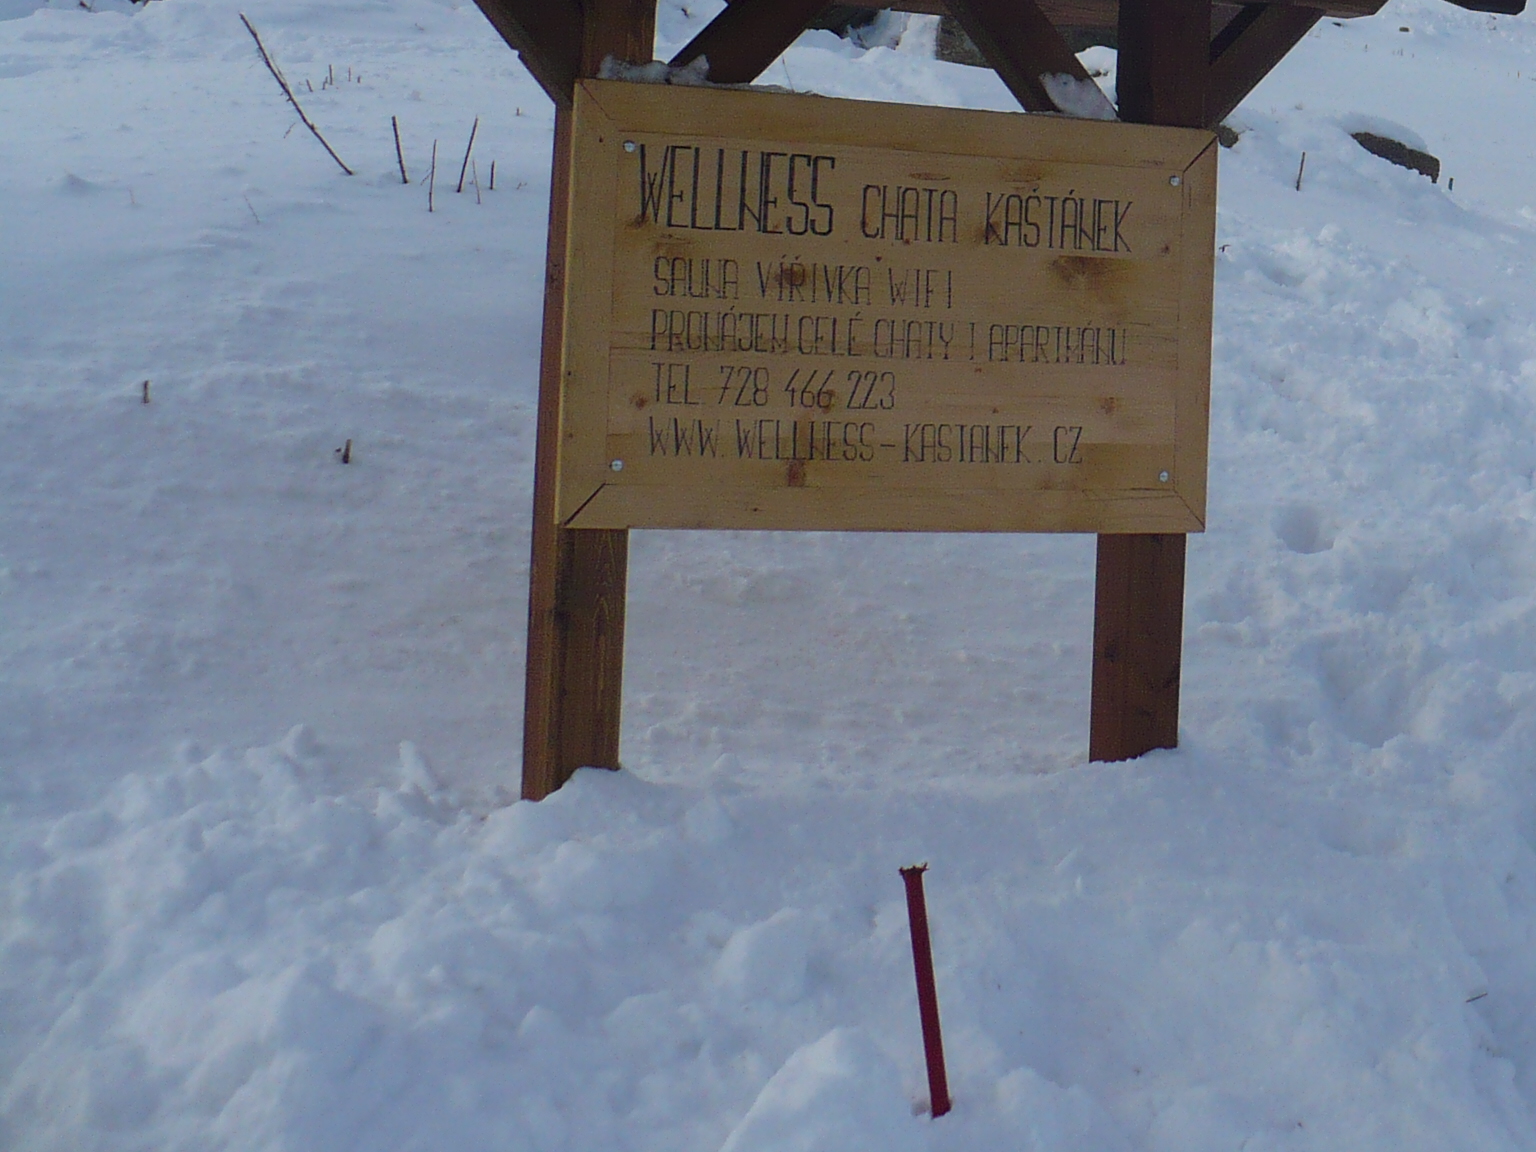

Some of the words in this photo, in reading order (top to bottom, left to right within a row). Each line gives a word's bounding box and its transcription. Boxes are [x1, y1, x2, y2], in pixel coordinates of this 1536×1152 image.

[639, 144, 835, 236] WELLNESS
[861, 184, 958, 243] CHATA
[653, 256, 739, 299] SAUNA
[888, 267, 952, 309] WIFI
[651, 305, 789, 352] PRONÁJEM
[798, 311, 864, 356] CELÉ
[874, 318, 954, 360] CHATY
[652, 363, 700, 405] TEL
[718, 365, 769, 406] 728
[785, 368, 834, 408] 466
[847, 370, 895, 410] 223
